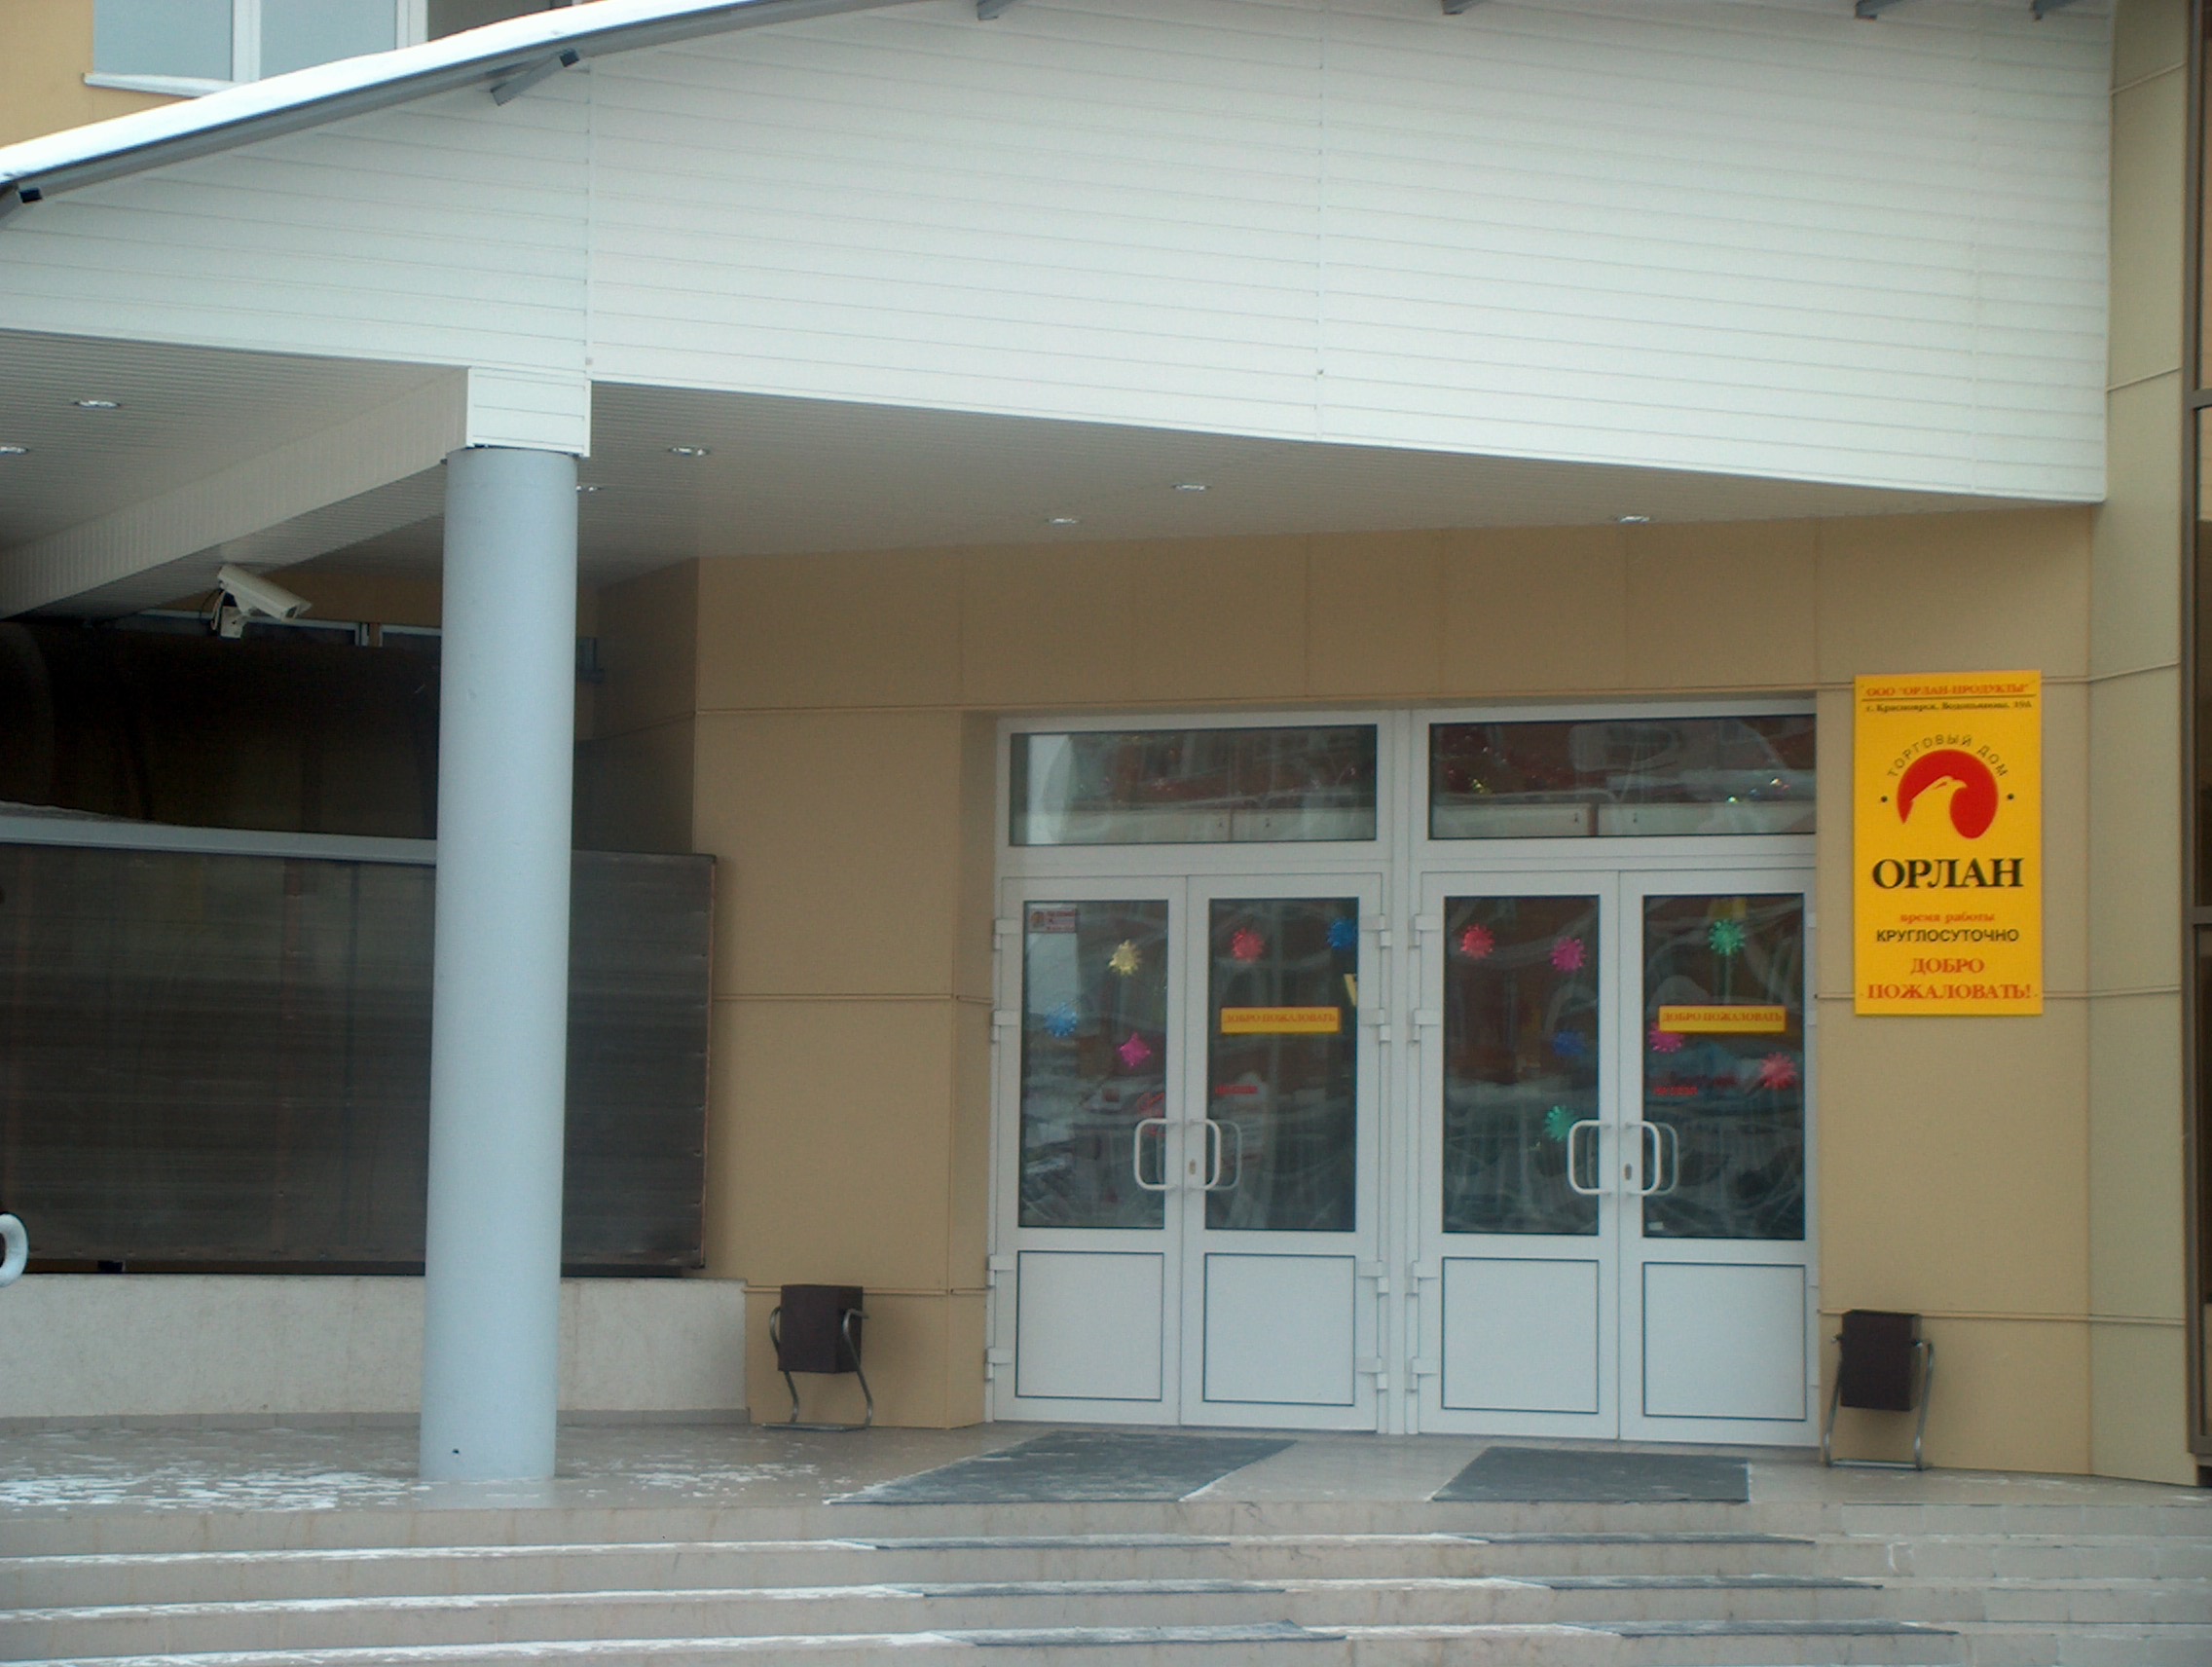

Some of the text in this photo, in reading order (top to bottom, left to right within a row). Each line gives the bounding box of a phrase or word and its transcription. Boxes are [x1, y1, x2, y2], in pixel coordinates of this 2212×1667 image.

[1866, 686, 1895, 697] ООО
[1886, 733, 2009, 779] ТОРГОВЫЙ ДОМ
[1872, 857, 2025, 889] ОРЛАН
[1899, 910, 1995, 924] время работы
[1876, 928, 2020, 943] КРУГЛОСУТОЧНО
[1910, 956, 1985, 975] ДОБРО
[1866, 982, 2032, 1000] ПОЖАЛОВАТЬ!
